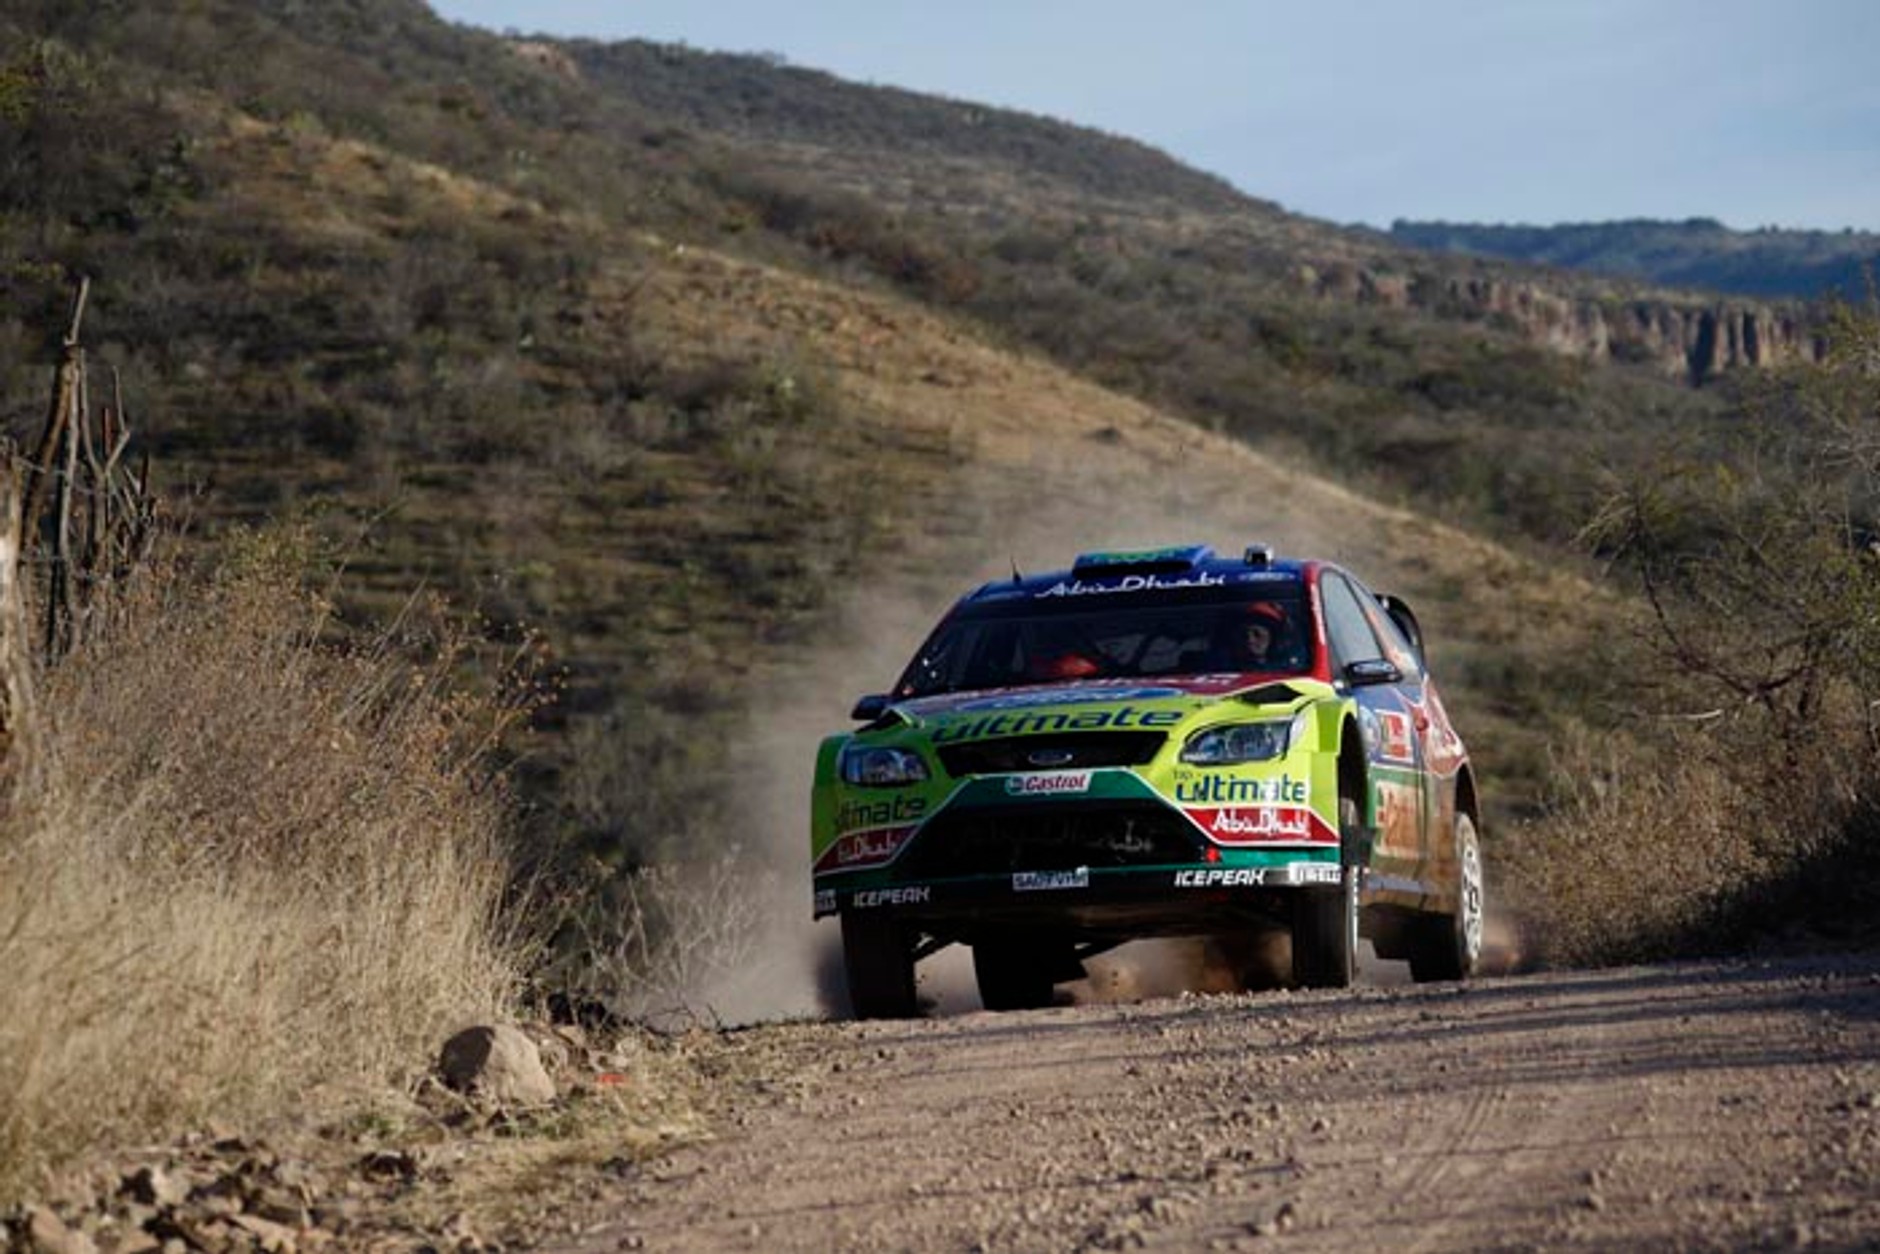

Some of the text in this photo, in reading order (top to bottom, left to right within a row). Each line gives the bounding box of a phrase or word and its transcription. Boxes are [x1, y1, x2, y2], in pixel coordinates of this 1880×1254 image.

[932, 704, 1185, 743] ultimate
[1026, 773, 1087, 790] Castrol
[1176, 772, 1307, 802] ultimate
[1174, 868, 1266, 887] ICEPEAK
[853, 885, 931, 907] ICEPEAK
